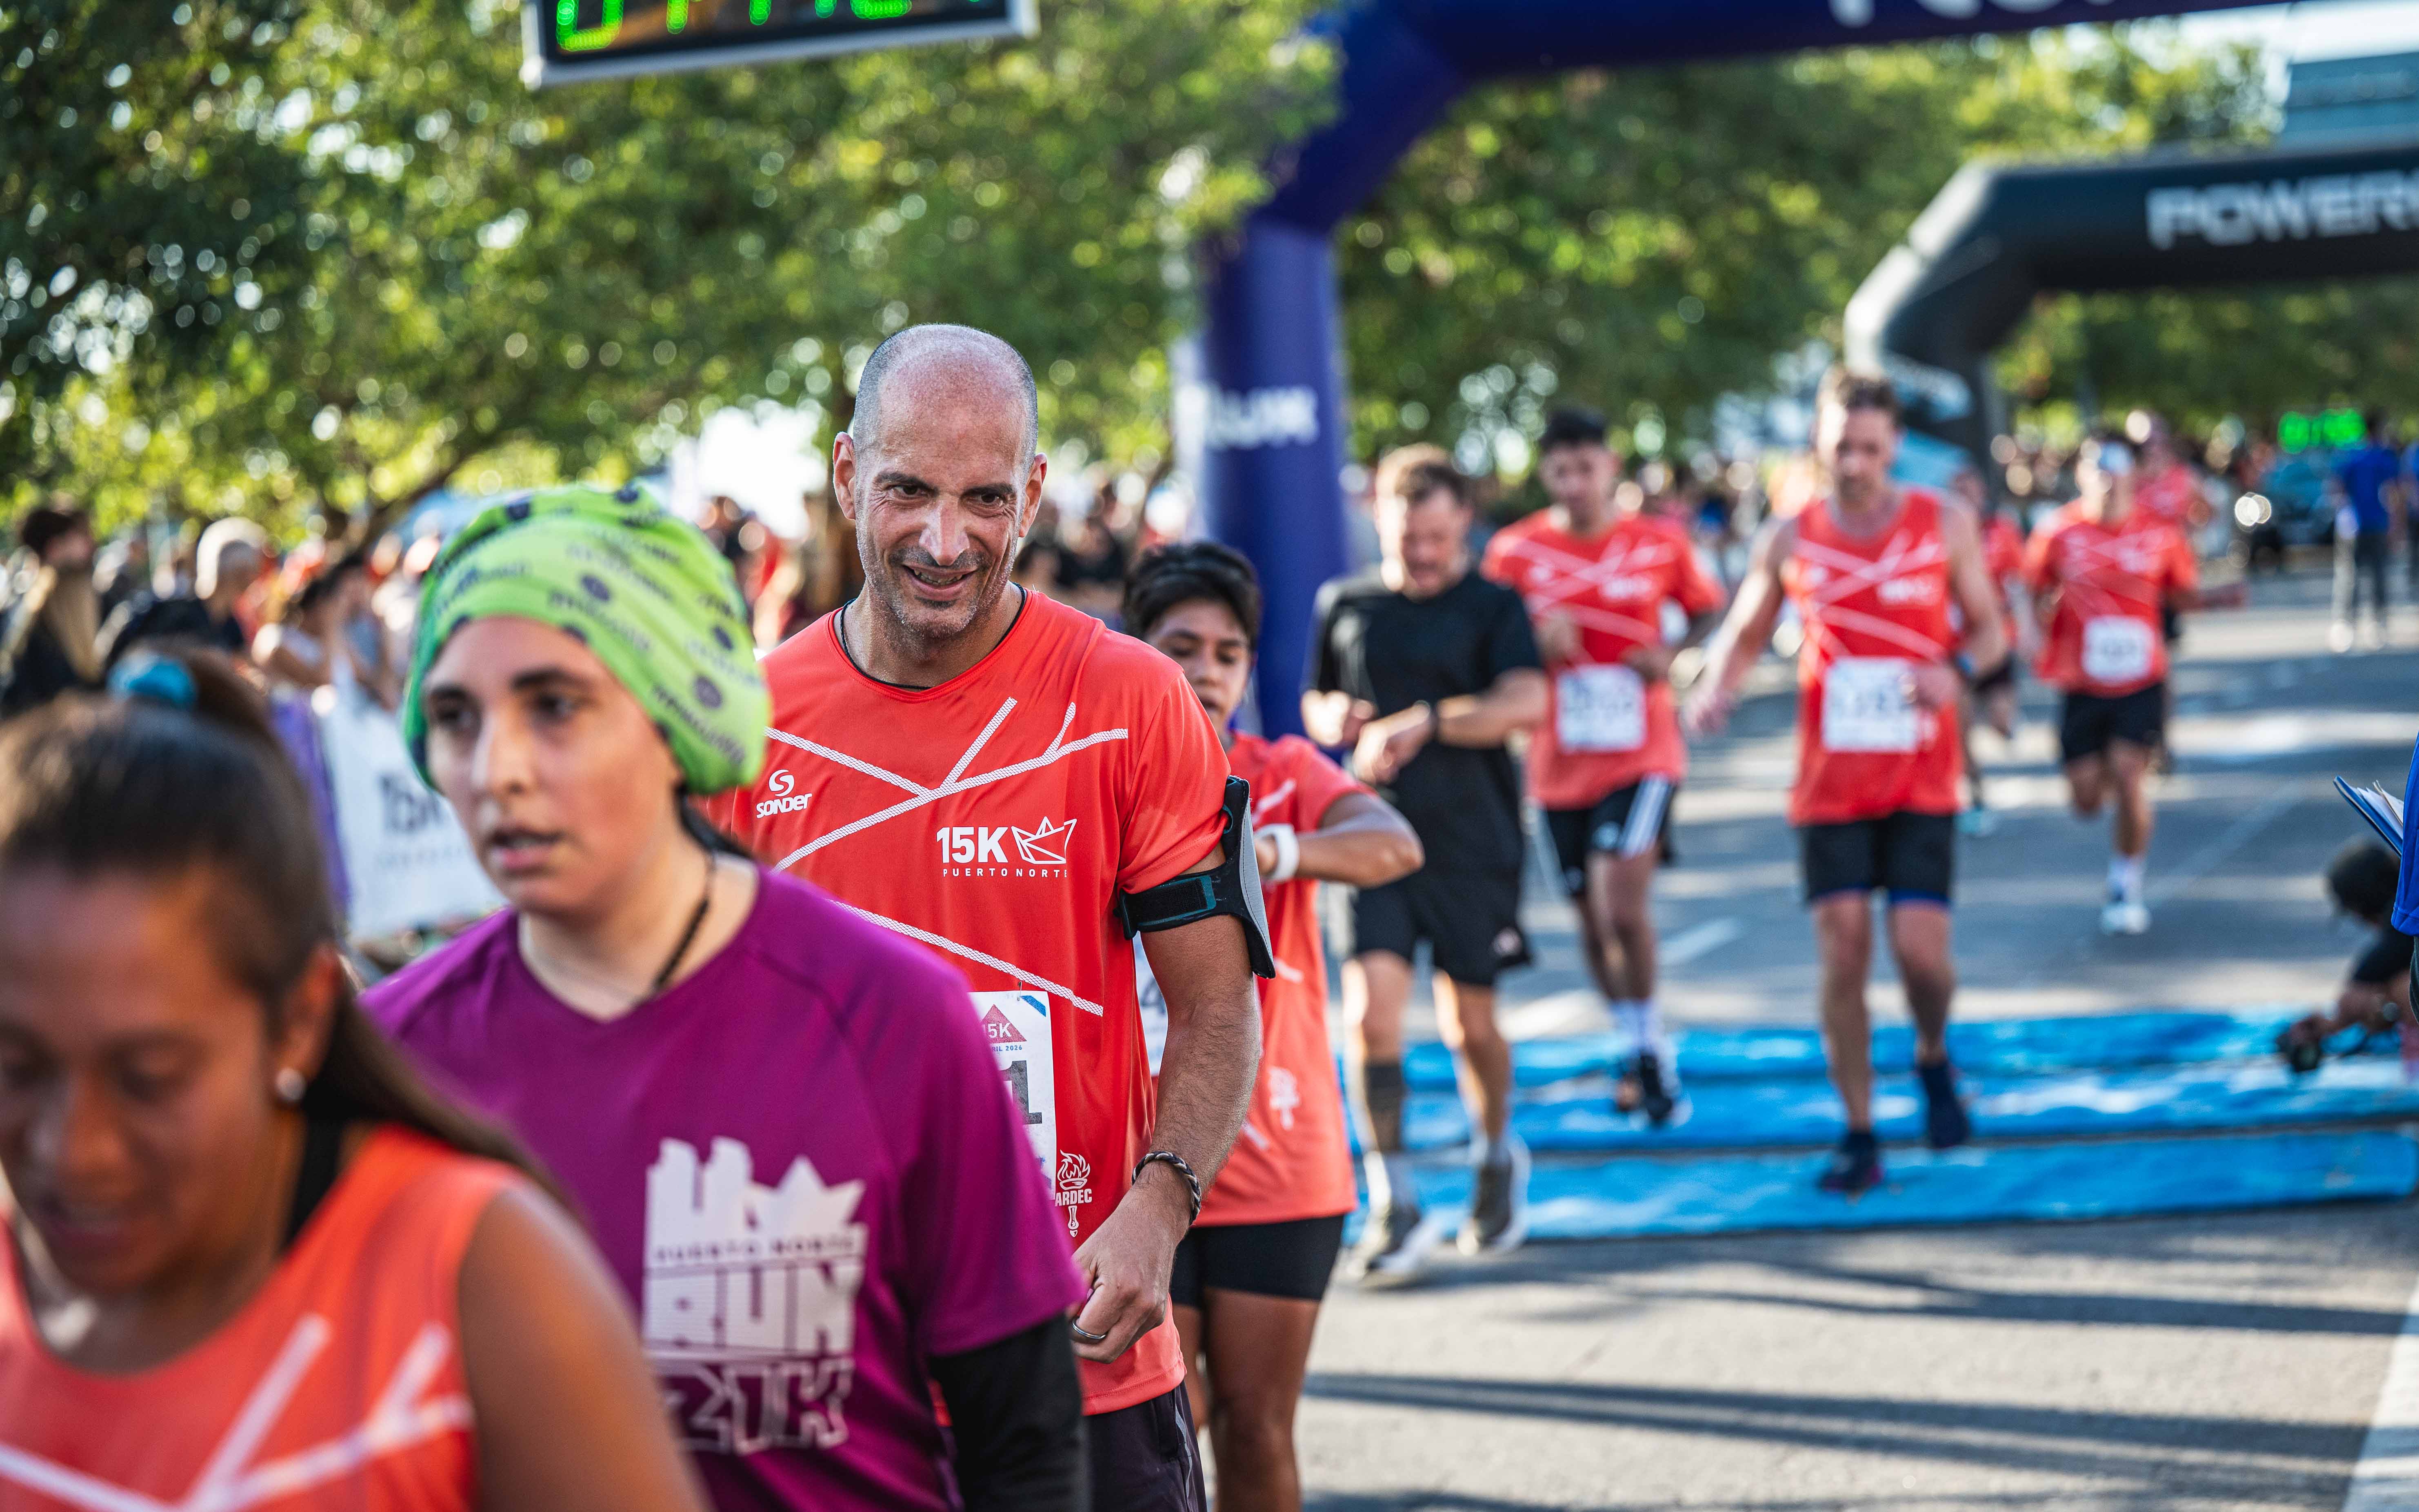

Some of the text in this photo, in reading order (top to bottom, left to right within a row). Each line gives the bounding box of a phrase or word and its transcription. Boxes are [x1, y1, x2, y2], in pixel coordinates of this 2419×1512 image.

[2146, 169, 2419, 246] POWER
[937, 827, 1008, 864] 15K
[943, 868, 1008, 877] PUERTO
[1055, 1188, 1092, 1207] ARDEC
[644, 1263, 863, 1351] RUN
